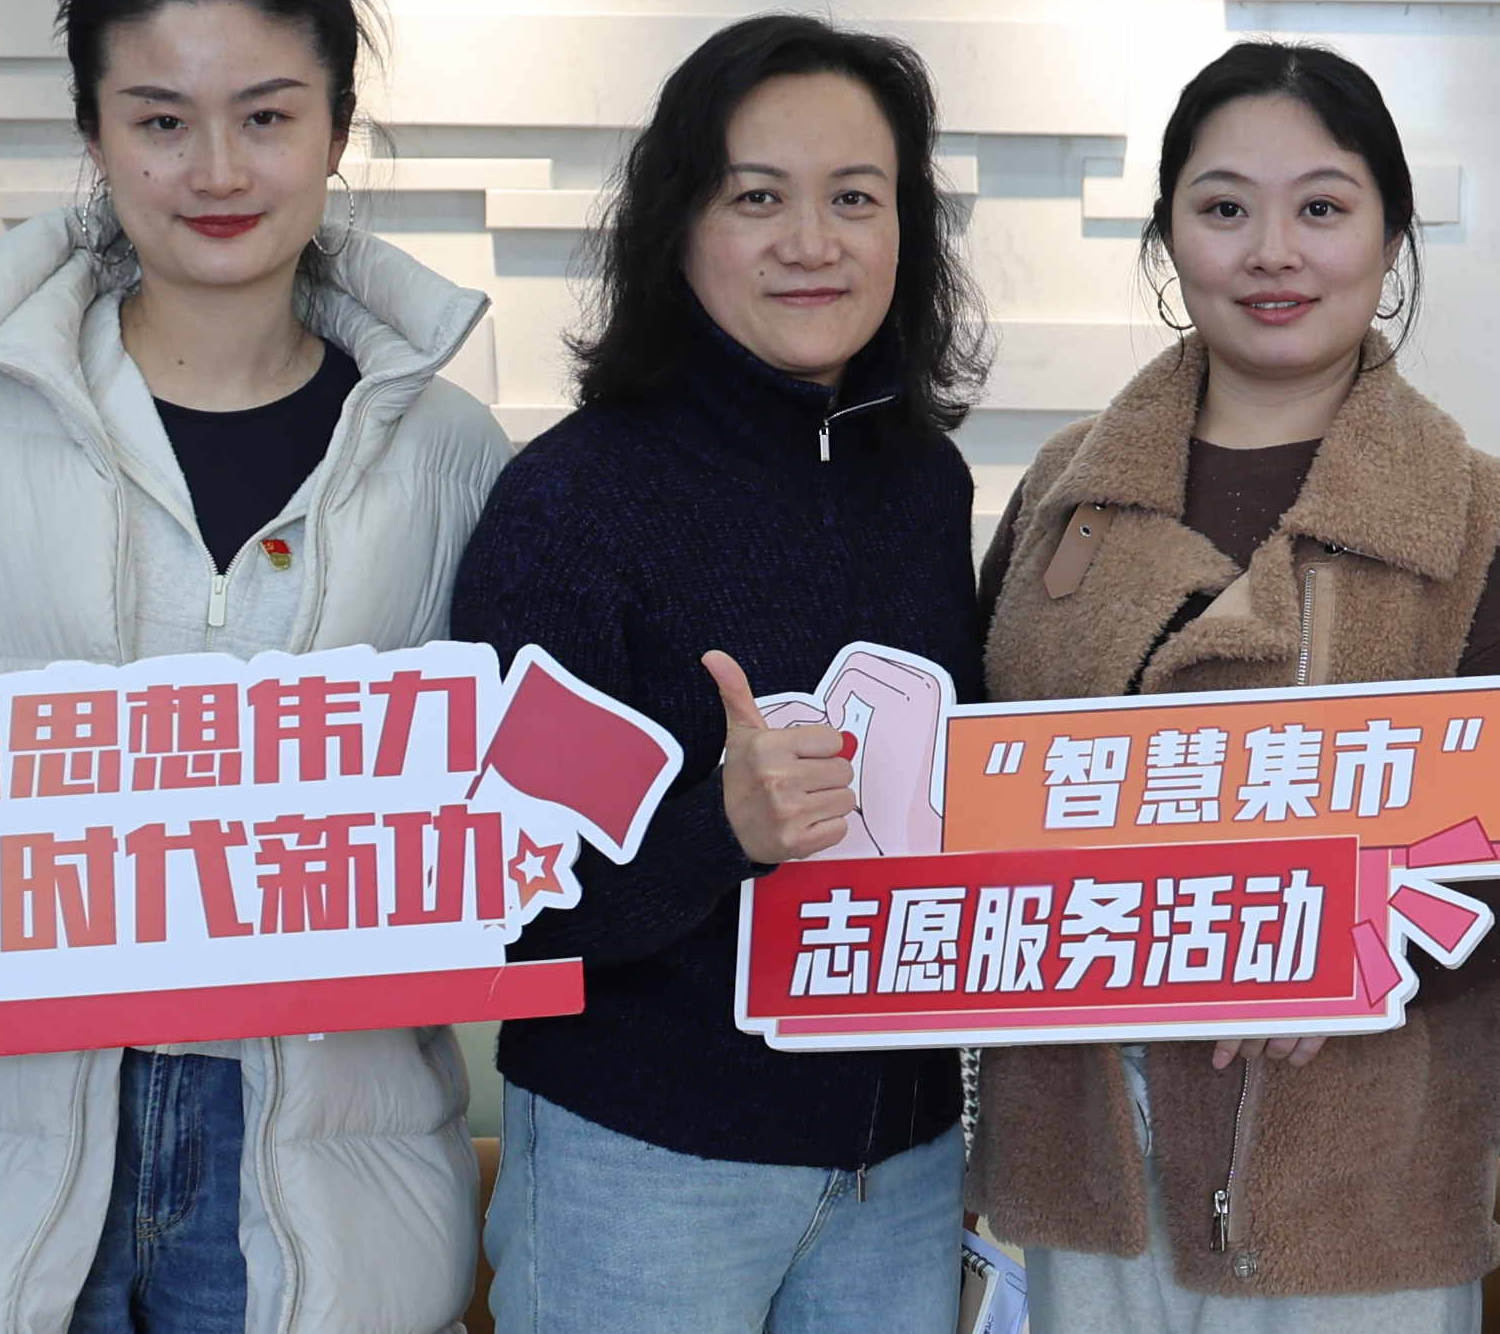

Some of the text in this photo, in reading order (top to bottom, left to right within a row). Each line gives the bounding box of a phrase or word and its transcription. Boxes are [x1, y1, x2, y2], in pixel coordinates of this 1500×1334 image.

[790, 869, 1325, 998] 志愿服务活动
